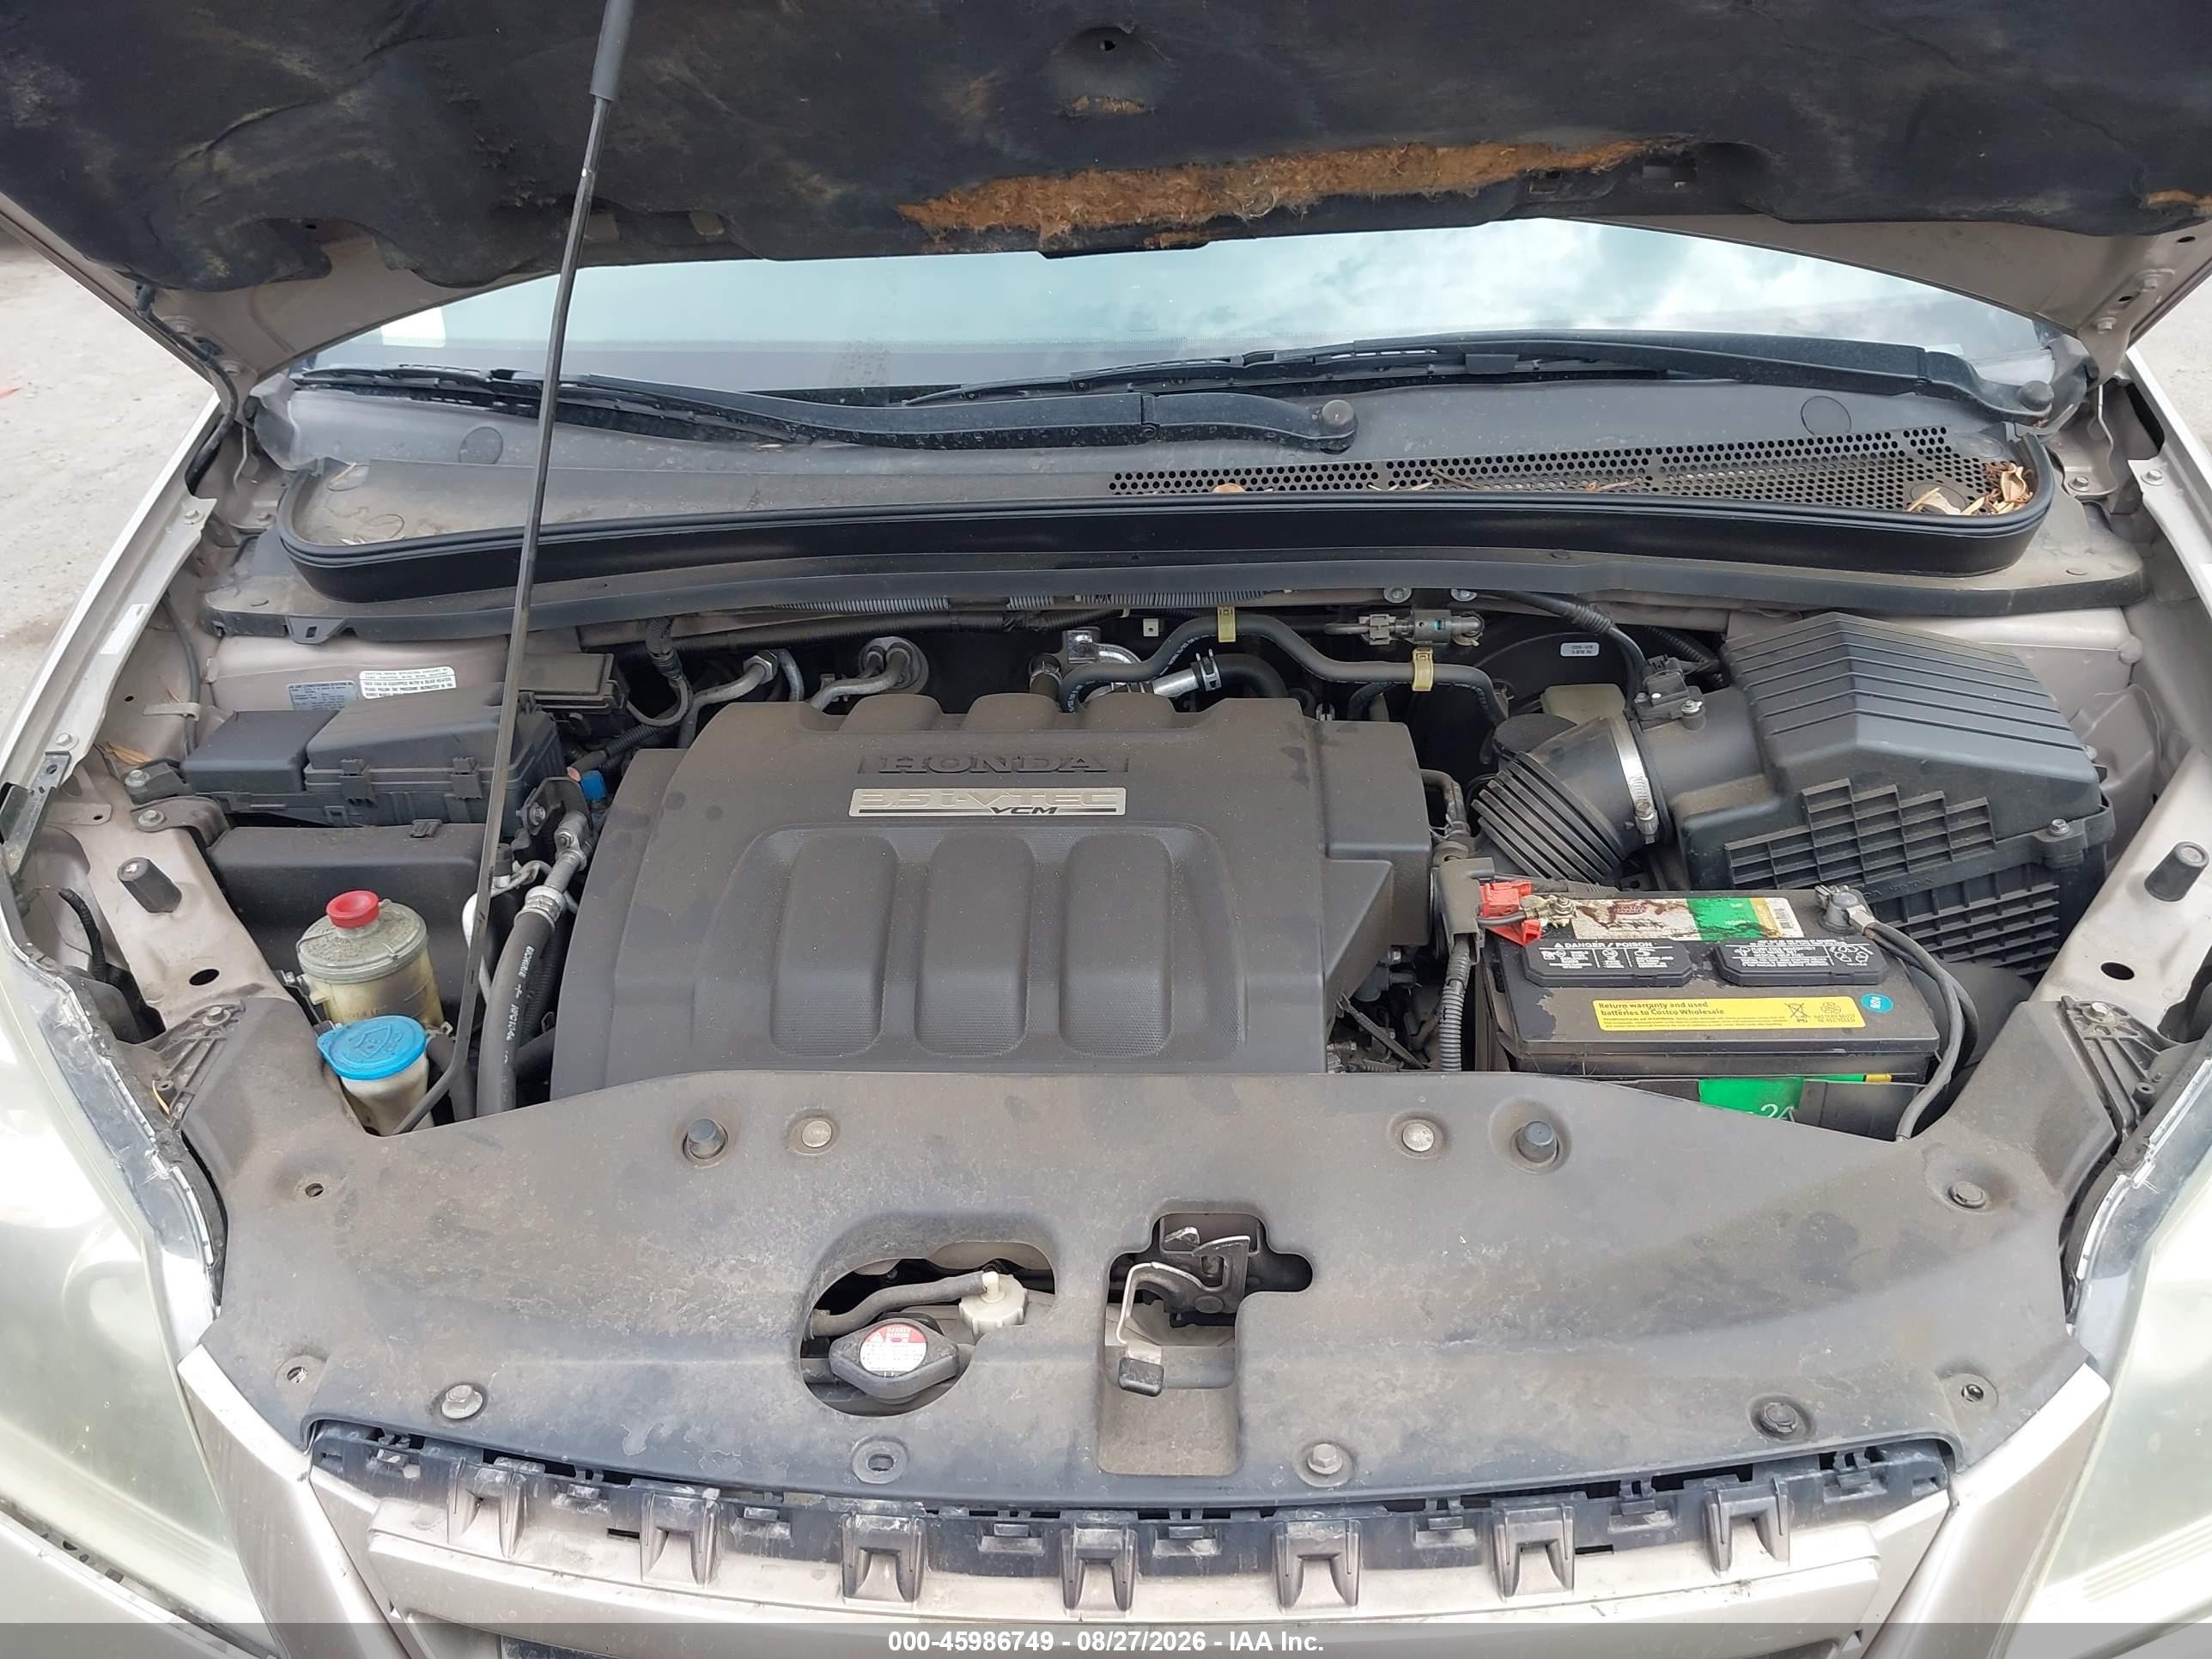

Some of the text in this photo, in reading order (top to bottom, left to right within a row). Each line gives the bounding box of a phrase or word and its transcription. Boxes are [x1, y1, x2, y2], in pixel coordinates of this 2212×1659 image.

[878, 755, 1109, 774] HONDA
[989, 806, 1059, 815] VCM
[1630, 1002, 1668, 1011] warranty
